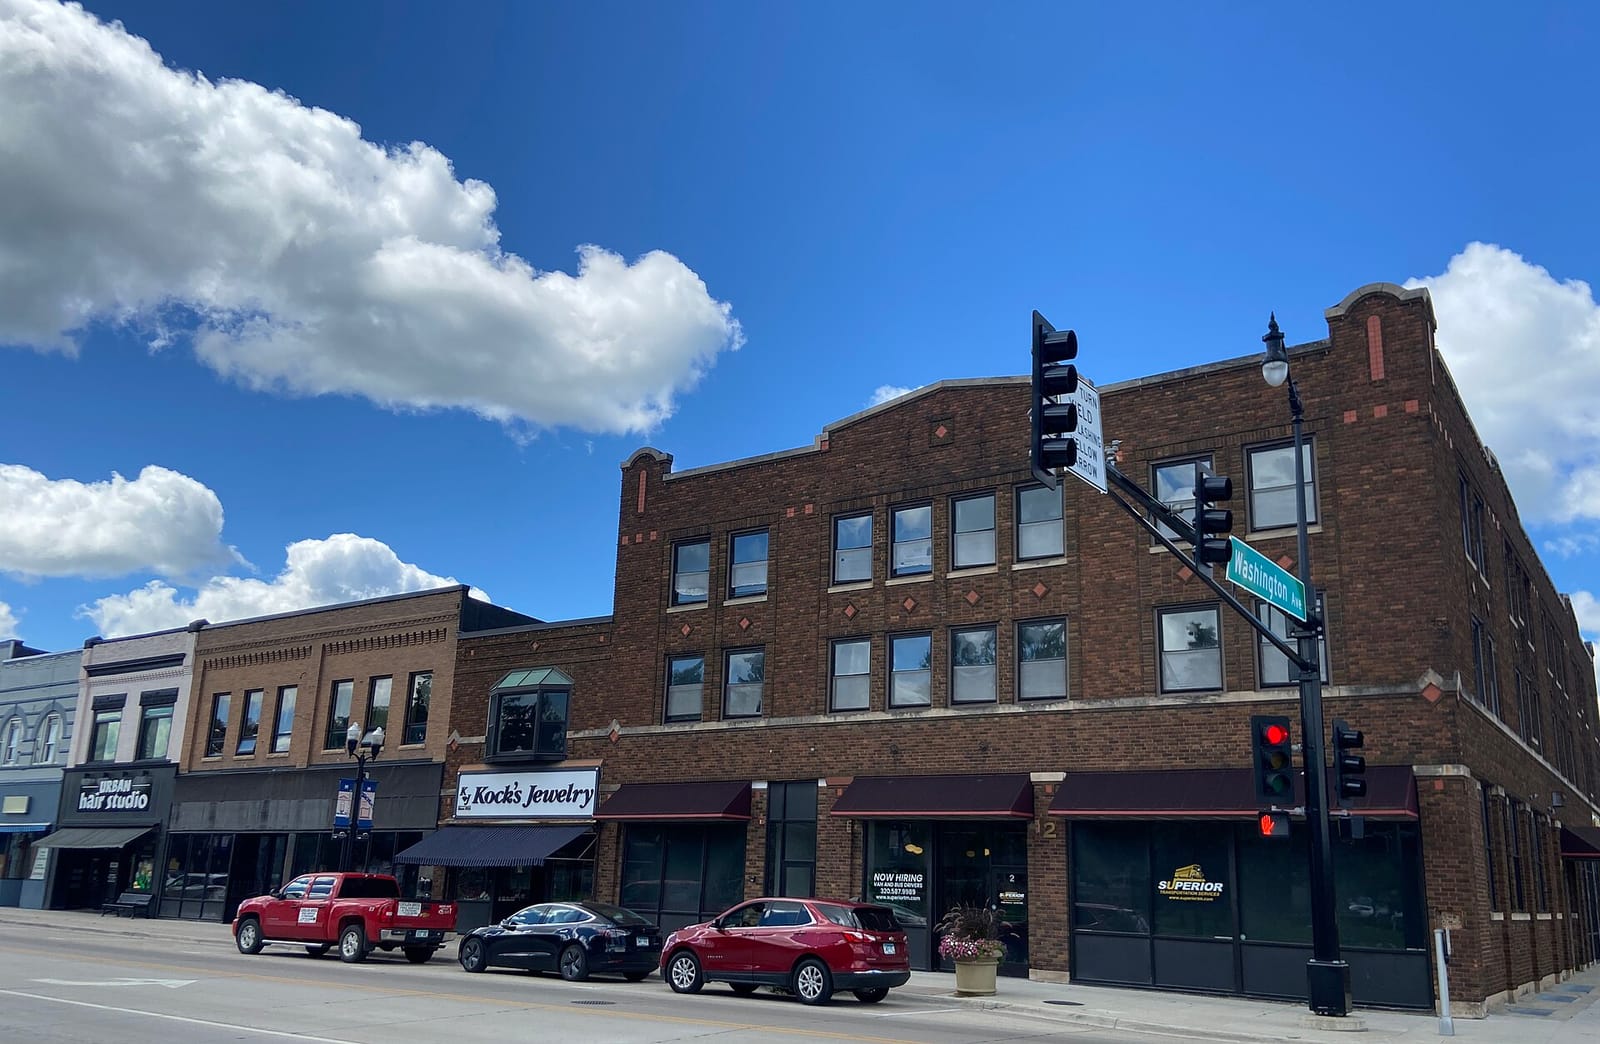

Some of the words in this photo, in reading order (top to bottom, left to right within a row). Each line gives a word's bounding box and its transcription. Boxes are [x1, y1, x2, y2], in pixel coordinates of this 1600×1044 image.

[1080, 387, 1098, 409] TURN
[1077, 425, 1101, 449] LASHING
[1073, 436, 1098, 462] ELLOW
[1234, 549, 1288, 601] Washington
[1291, 593, 1302, 610] Ave
[99, 780, 132, 793] URBAN
[472, 781, 522, 804] Kock's
[523, 783, 594, 808] Jewelry
[79, 792, 105, 809] hair
[105, 791, 148, 809] studio
[1043, 822, 1057, 838] 2
[873, 872, 894, 881] NOW
[895, 873, 923, 882] HIRING
[1009, 874, 1015, 882] 2
[1158, 880, 1223, 892] SUPERIOR
